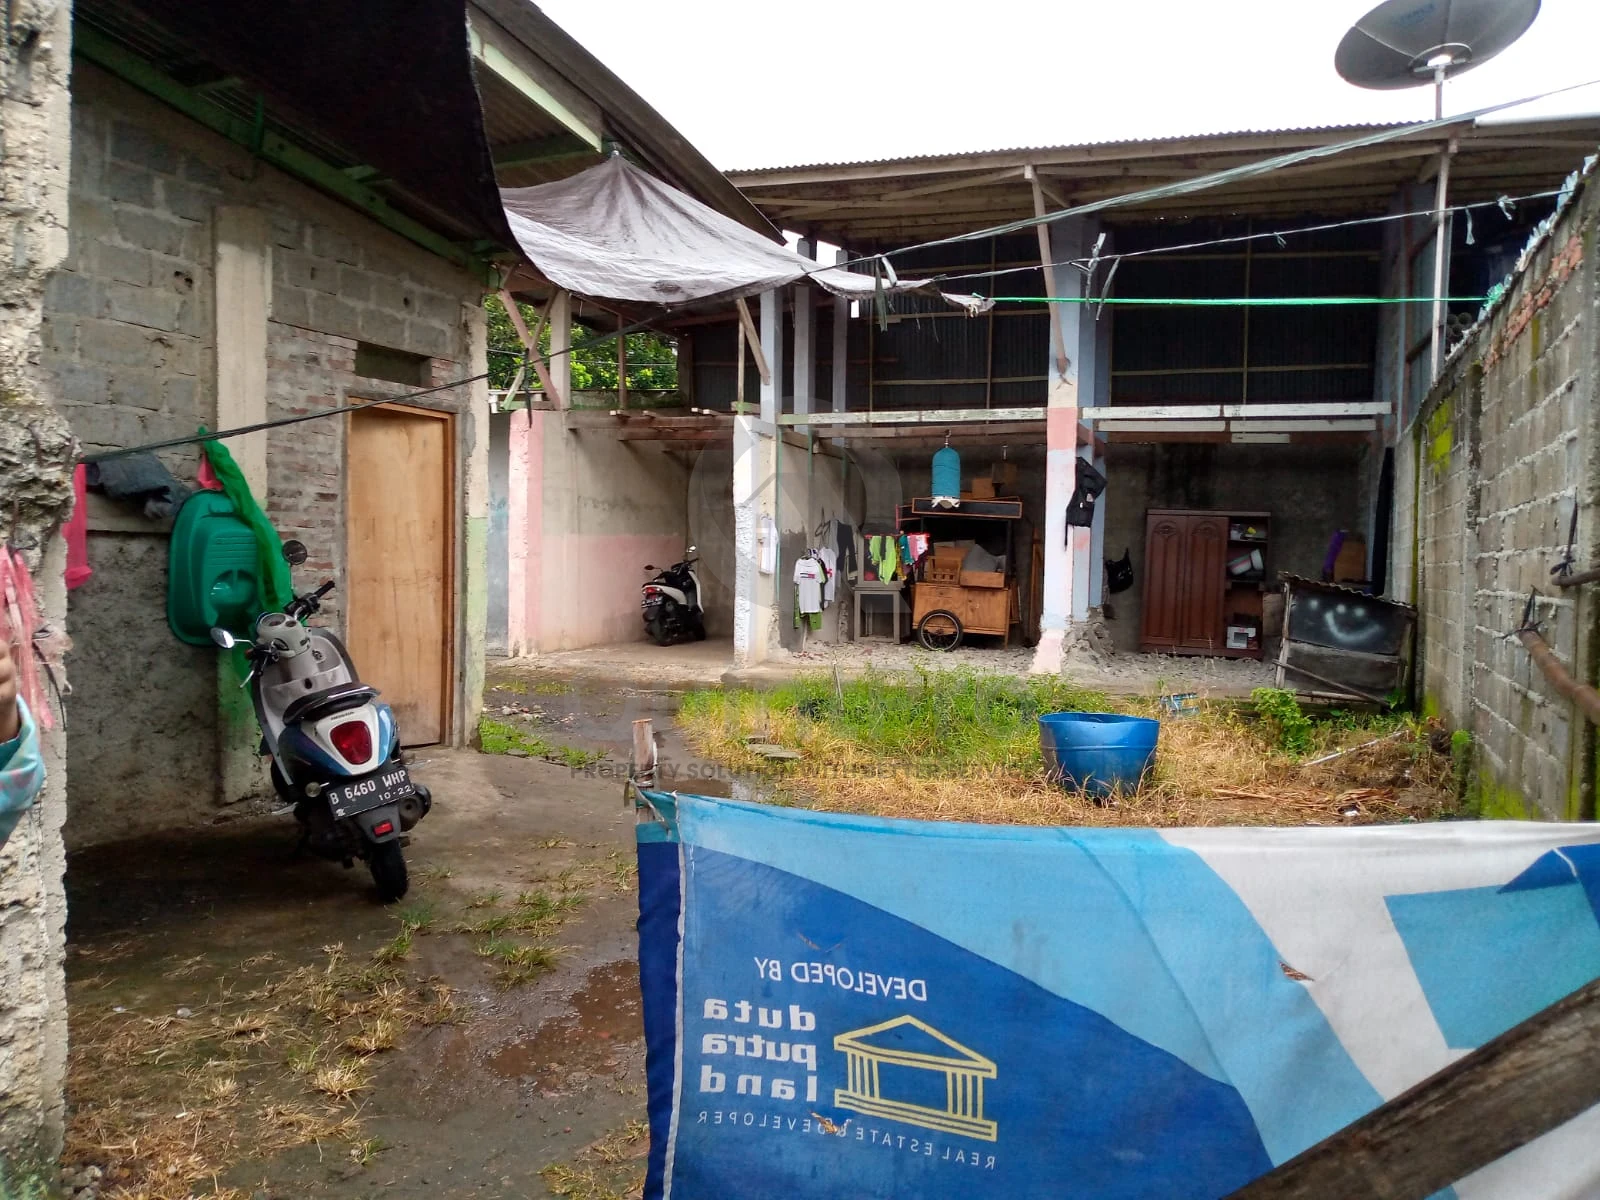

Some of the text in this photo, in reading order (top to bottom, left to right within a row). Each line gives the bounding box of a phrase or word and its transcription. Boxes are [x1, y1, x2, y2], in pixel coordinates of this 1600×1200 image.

[329, 770, 406, 805] B 6460 WHP
